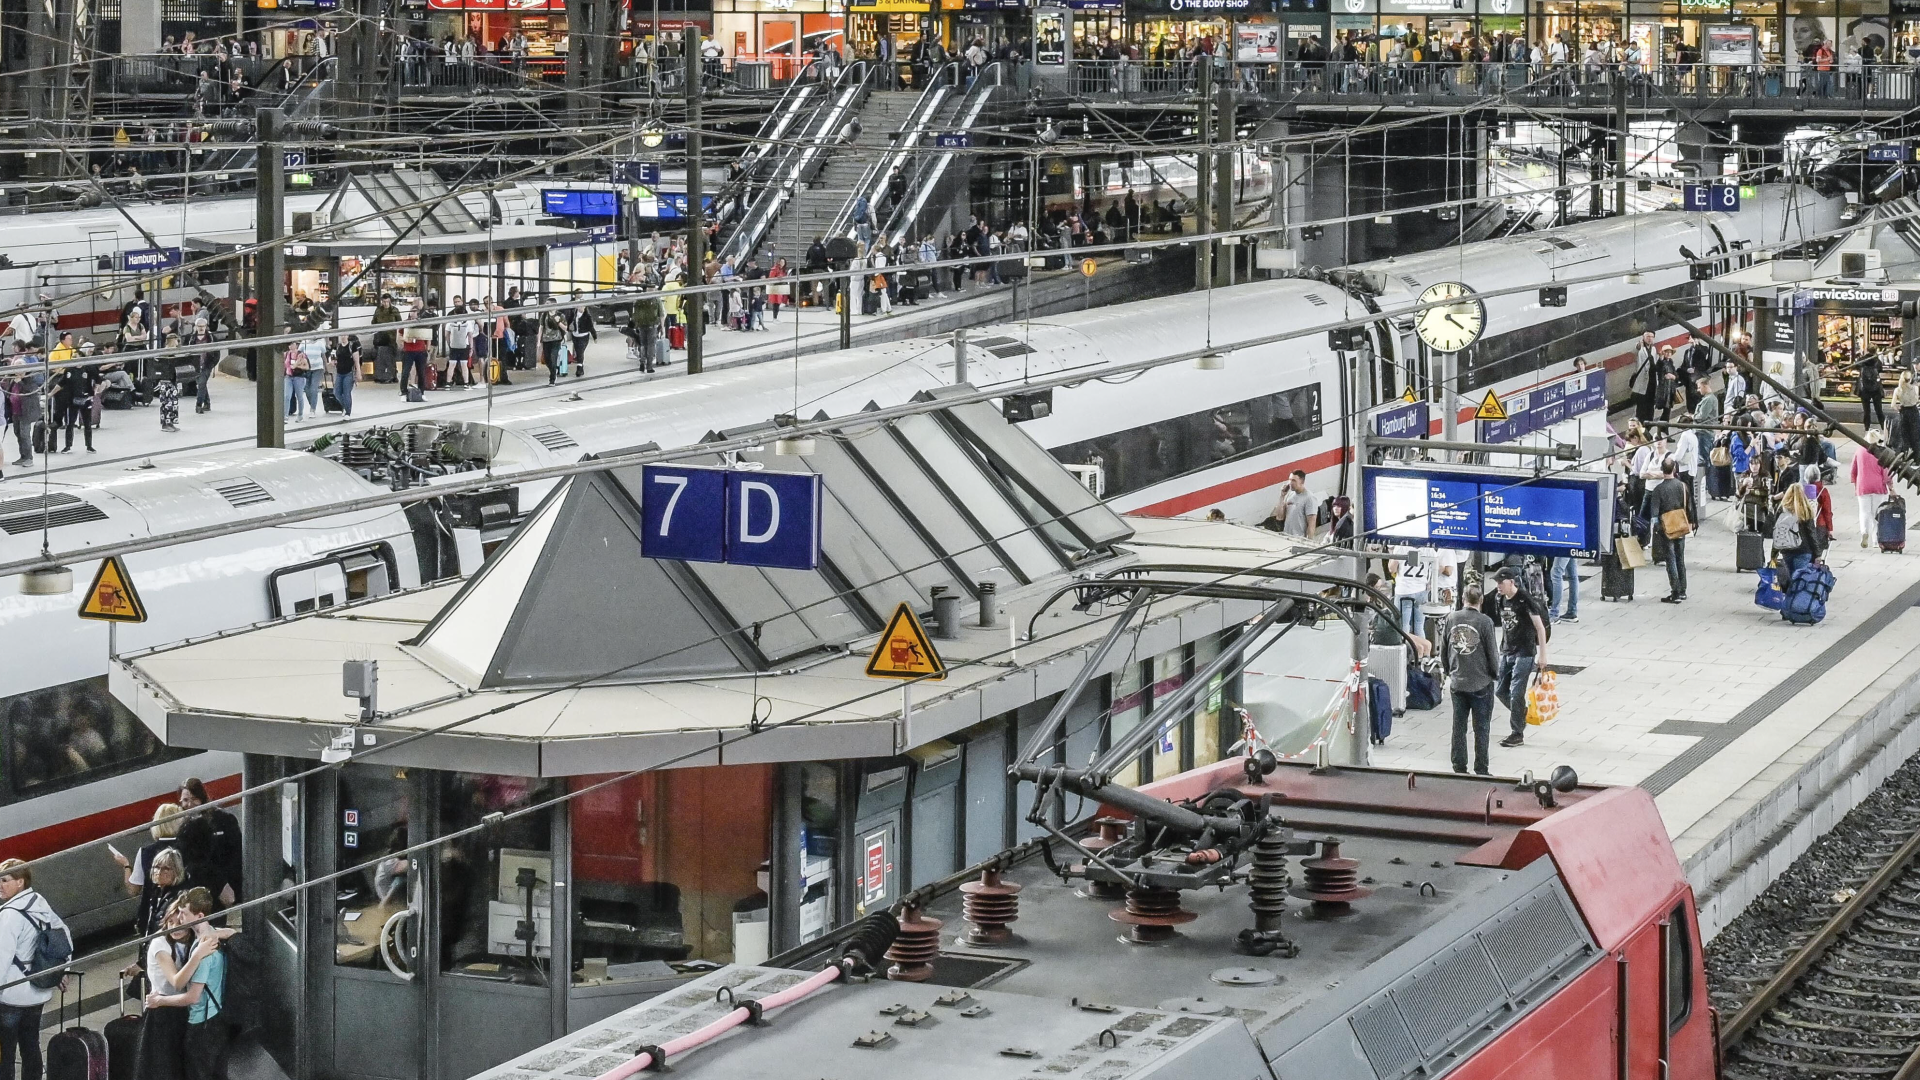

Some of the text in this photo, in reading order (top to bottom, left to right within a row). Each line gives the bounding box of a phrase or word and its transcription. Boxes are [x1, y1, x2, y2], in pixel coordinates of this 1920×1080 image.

[1185, 0, 1249, 8] THE BODY SHOP
[285, 154, 301, 167] 12
[640, 163, 650, 180] E
[1694, 187, 1736, 207] E 8
[128, 253, 157, 265] Hamburg
[1312, 390, 1319, 411] 2
[1381, 408, 1417, 437] Hamburg Hbf
[1484, 495, 1504, 504] 16:21
[654, 475, 780, 543] 7 D
[1484, 505, 1521, 516] Brahlstorf
[1570, 548, 1597, 559] Gleis 7
[1404, 560, 1425, 578] 22
